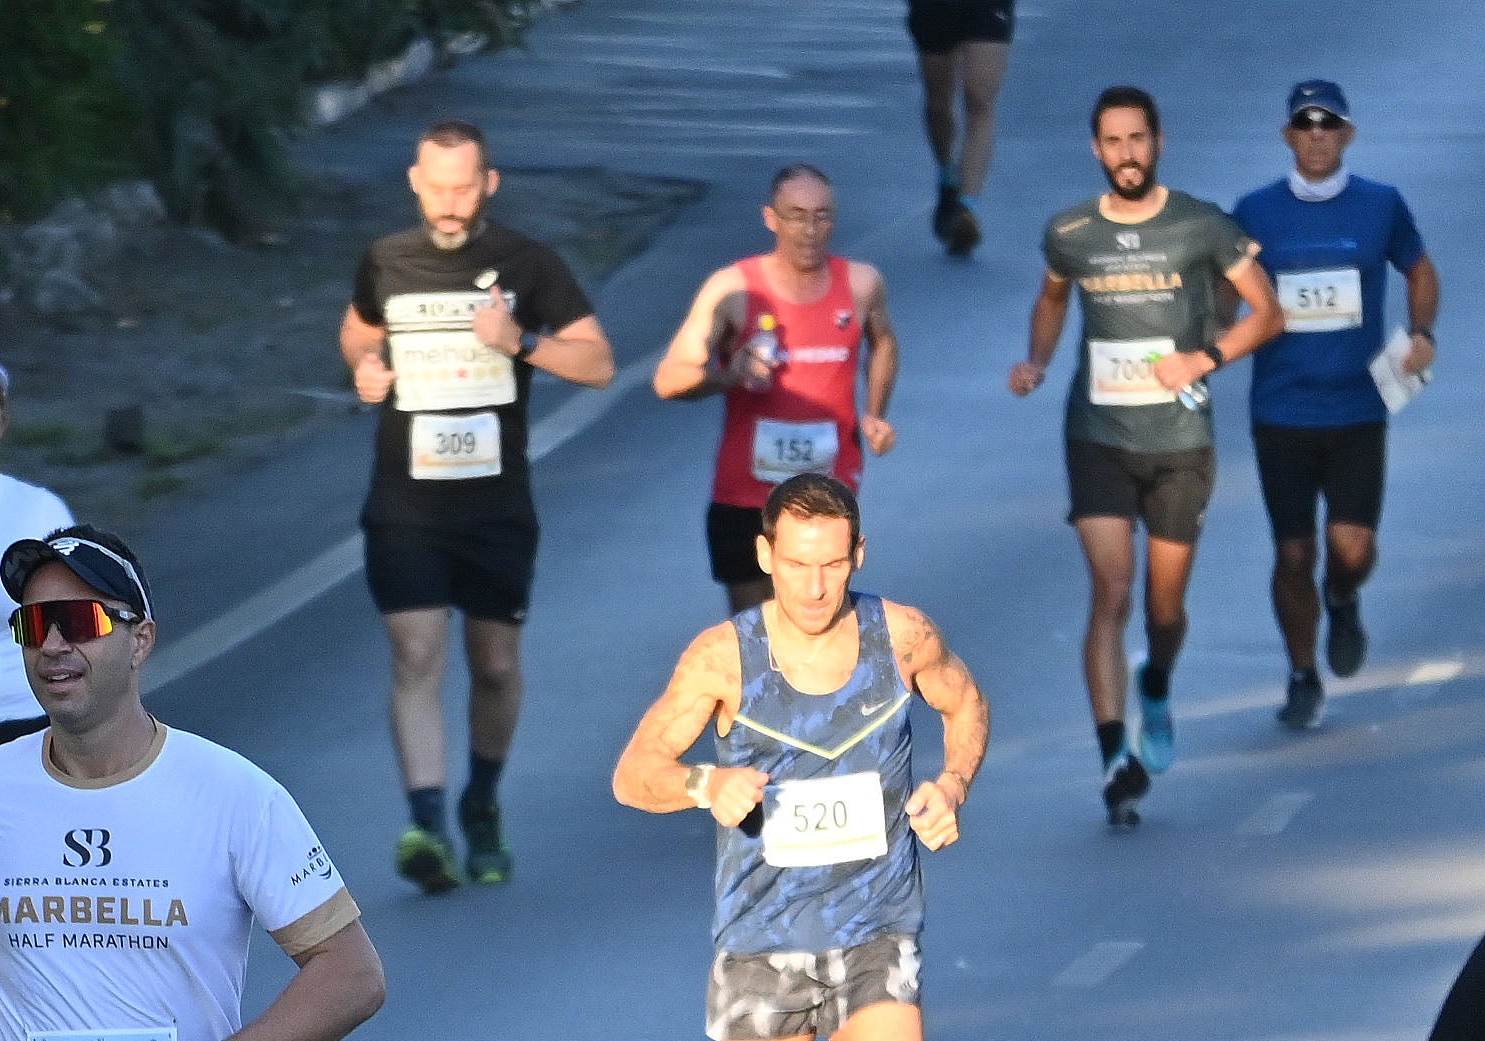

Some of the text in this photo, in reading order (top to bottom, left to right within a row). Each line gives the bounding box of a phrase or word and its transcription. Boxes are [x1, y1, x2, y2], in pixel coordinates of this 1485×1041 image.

[1298, 286, 1337, 309] 512
[434, 431, 476, 455] 309
[775, 438, 814, 462] 152
[794, 800, 848, 832] 520
[62, 828, 112, 868] SB
[3, 876, 170, 889] SIERRA BLANCA ESTATES
[9, 932, 169, 950] HALF MARATHON
